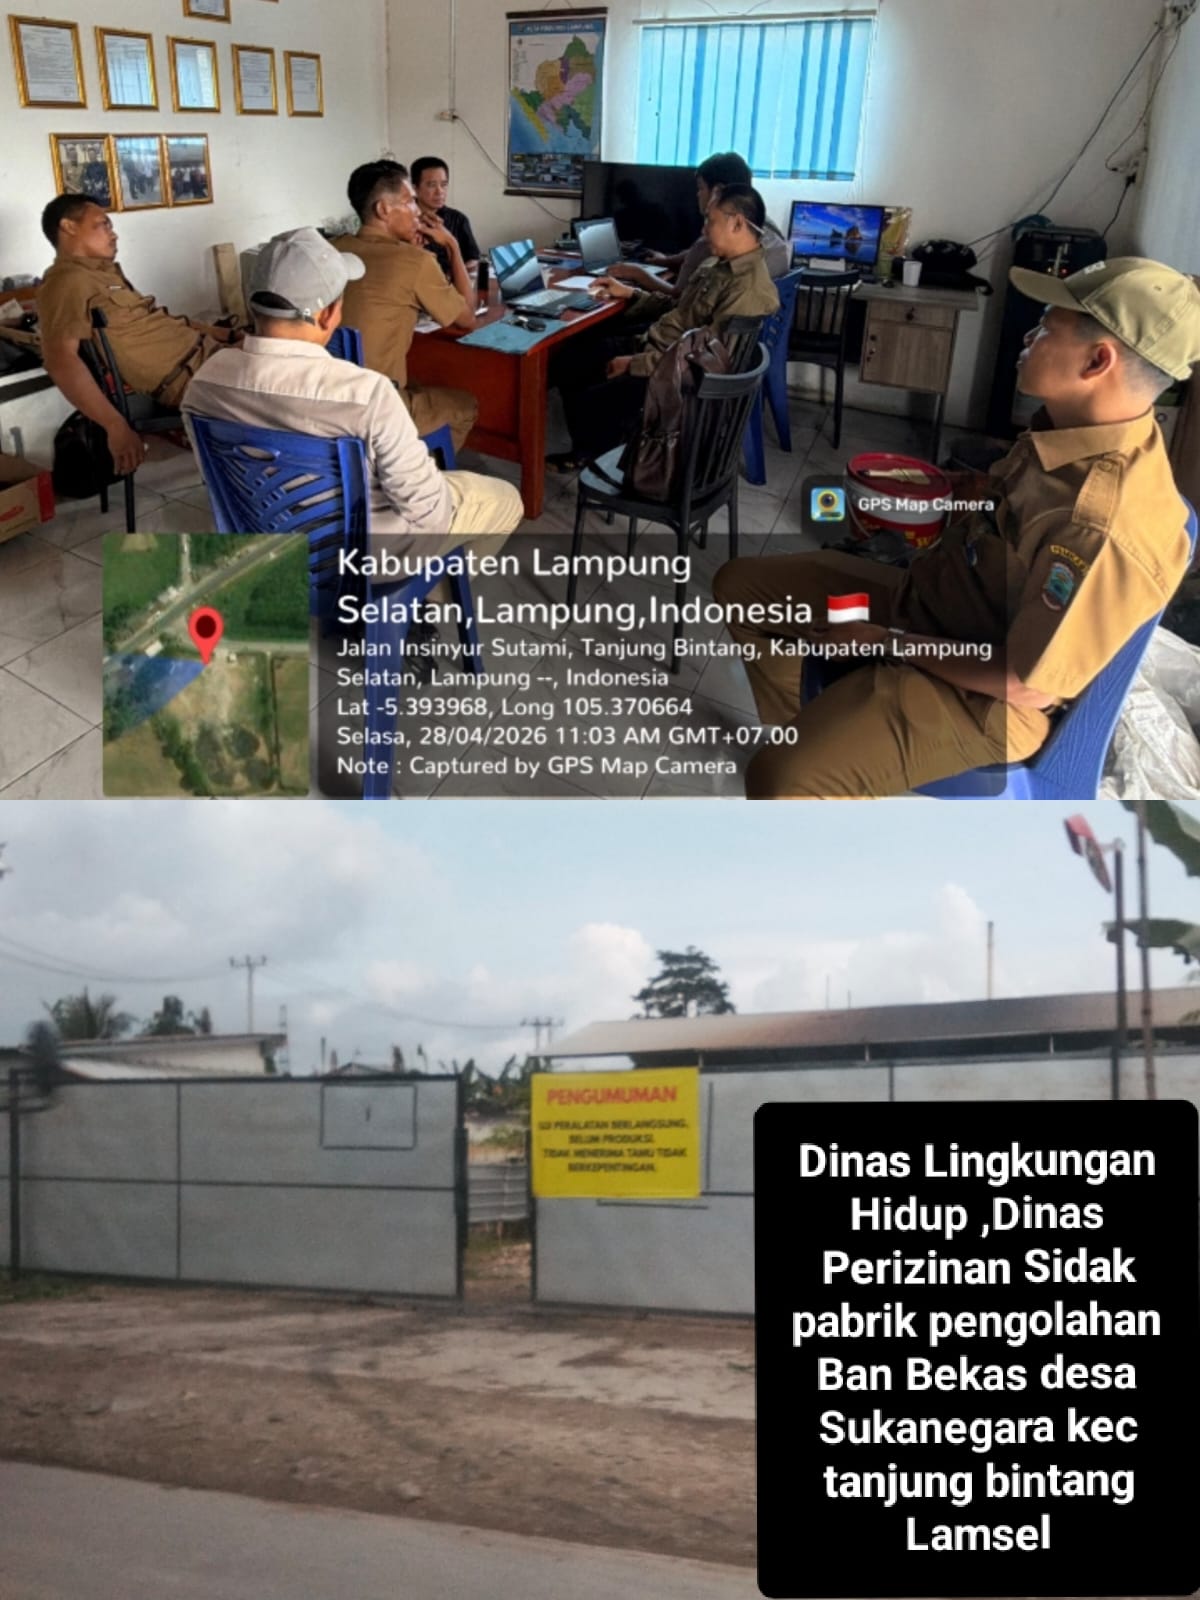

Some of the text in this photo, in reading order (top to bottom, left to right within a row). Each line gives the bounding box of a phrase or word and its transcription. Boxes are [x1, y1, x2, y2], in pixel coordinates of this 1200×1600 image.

[547, 1086, 677, 1105] PENGUMUMAN
[554, 1120, 608, 1130] PERALATAN
[544, 1147, 687, 1158] TIDAK MENERIMA TAMU TIDAK
